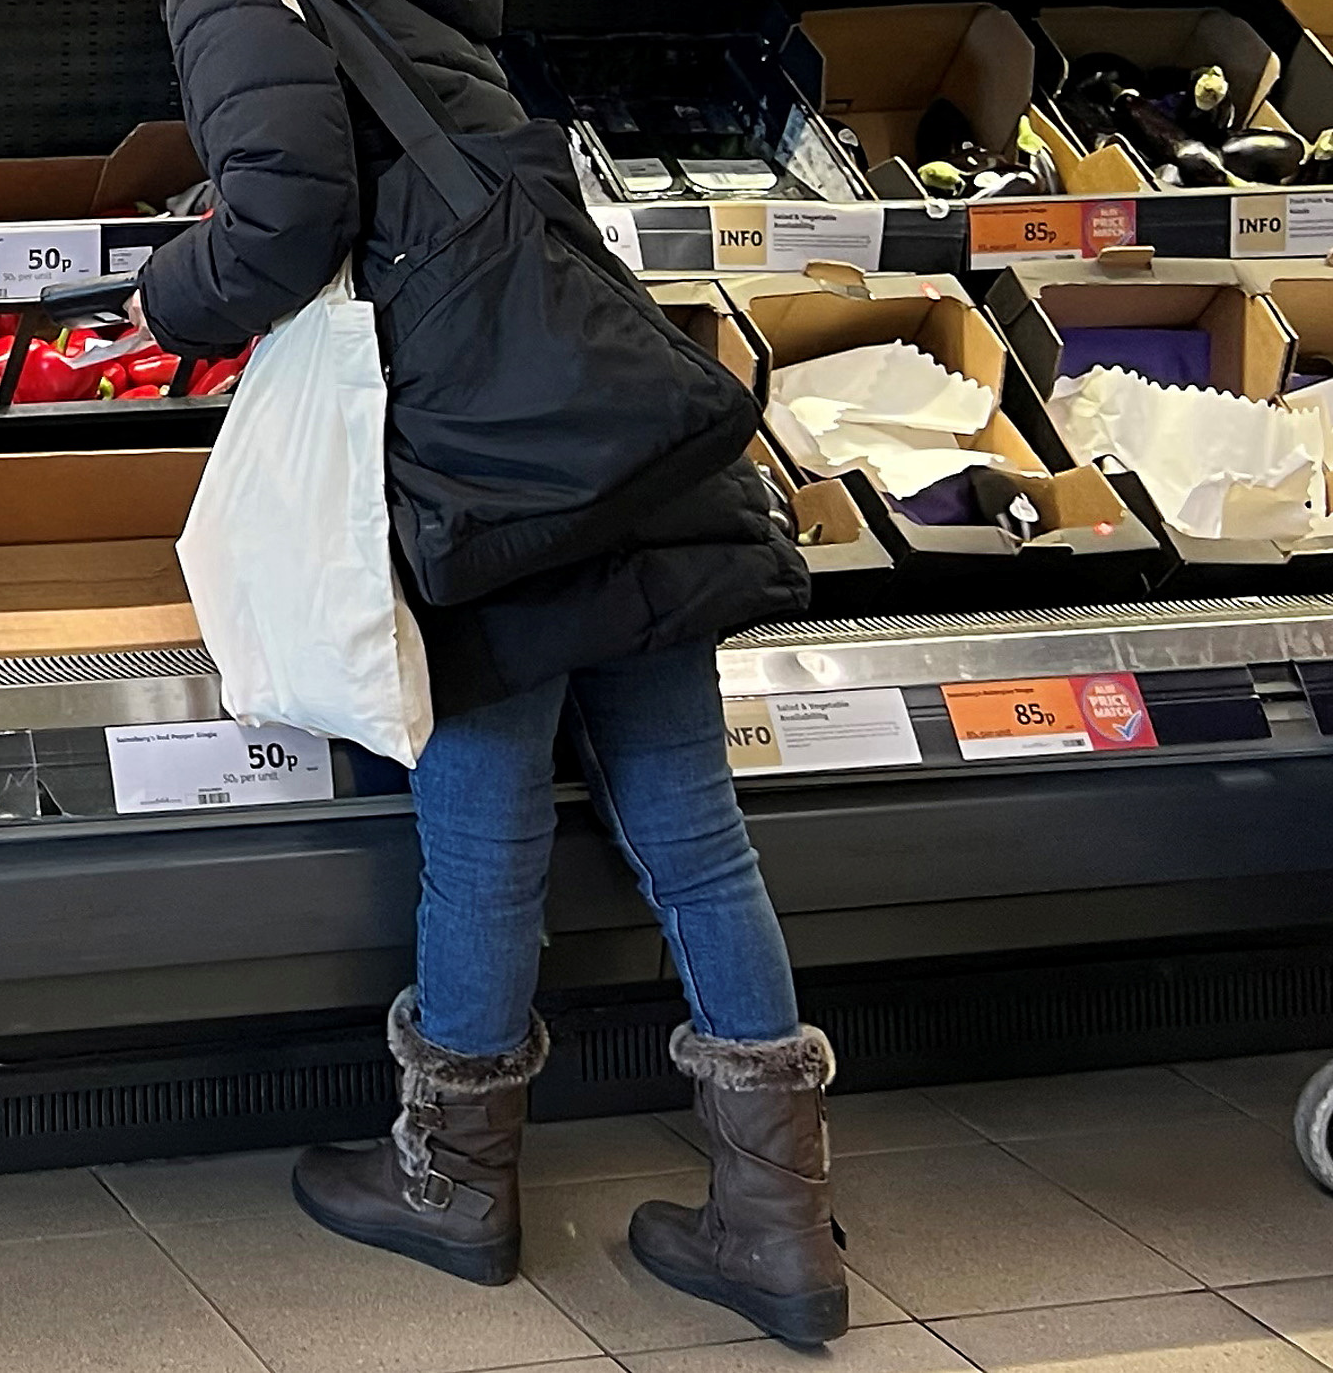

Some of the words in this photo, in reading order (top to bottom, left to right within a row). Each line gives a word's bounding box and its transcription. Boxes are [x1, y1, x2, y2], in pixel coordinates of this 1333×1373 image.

[1092, 217, 1125, 228] PRICE
[1238, 217, 1281, 235] INFO
[719, 230, 763, 247] INFO
[1024, 222, 1057, 244] 85p
[28, 248, 72, 272] 50p
[18, 273, 33, 282] per
[34, 272, 52, 281] unit
[1088, 694, 1130, 707] PRICE
[1014, 703, 1056, 727] 85p
[1092, 706, 1134, 718] MATCH
[171, 732, 195, 740] Pepper
[726, 726, 771, 747] NFO
[248, 742, 298, 771] 50p
[240, 773, 256, 784] per
[258, 771, 279, 781] unit
